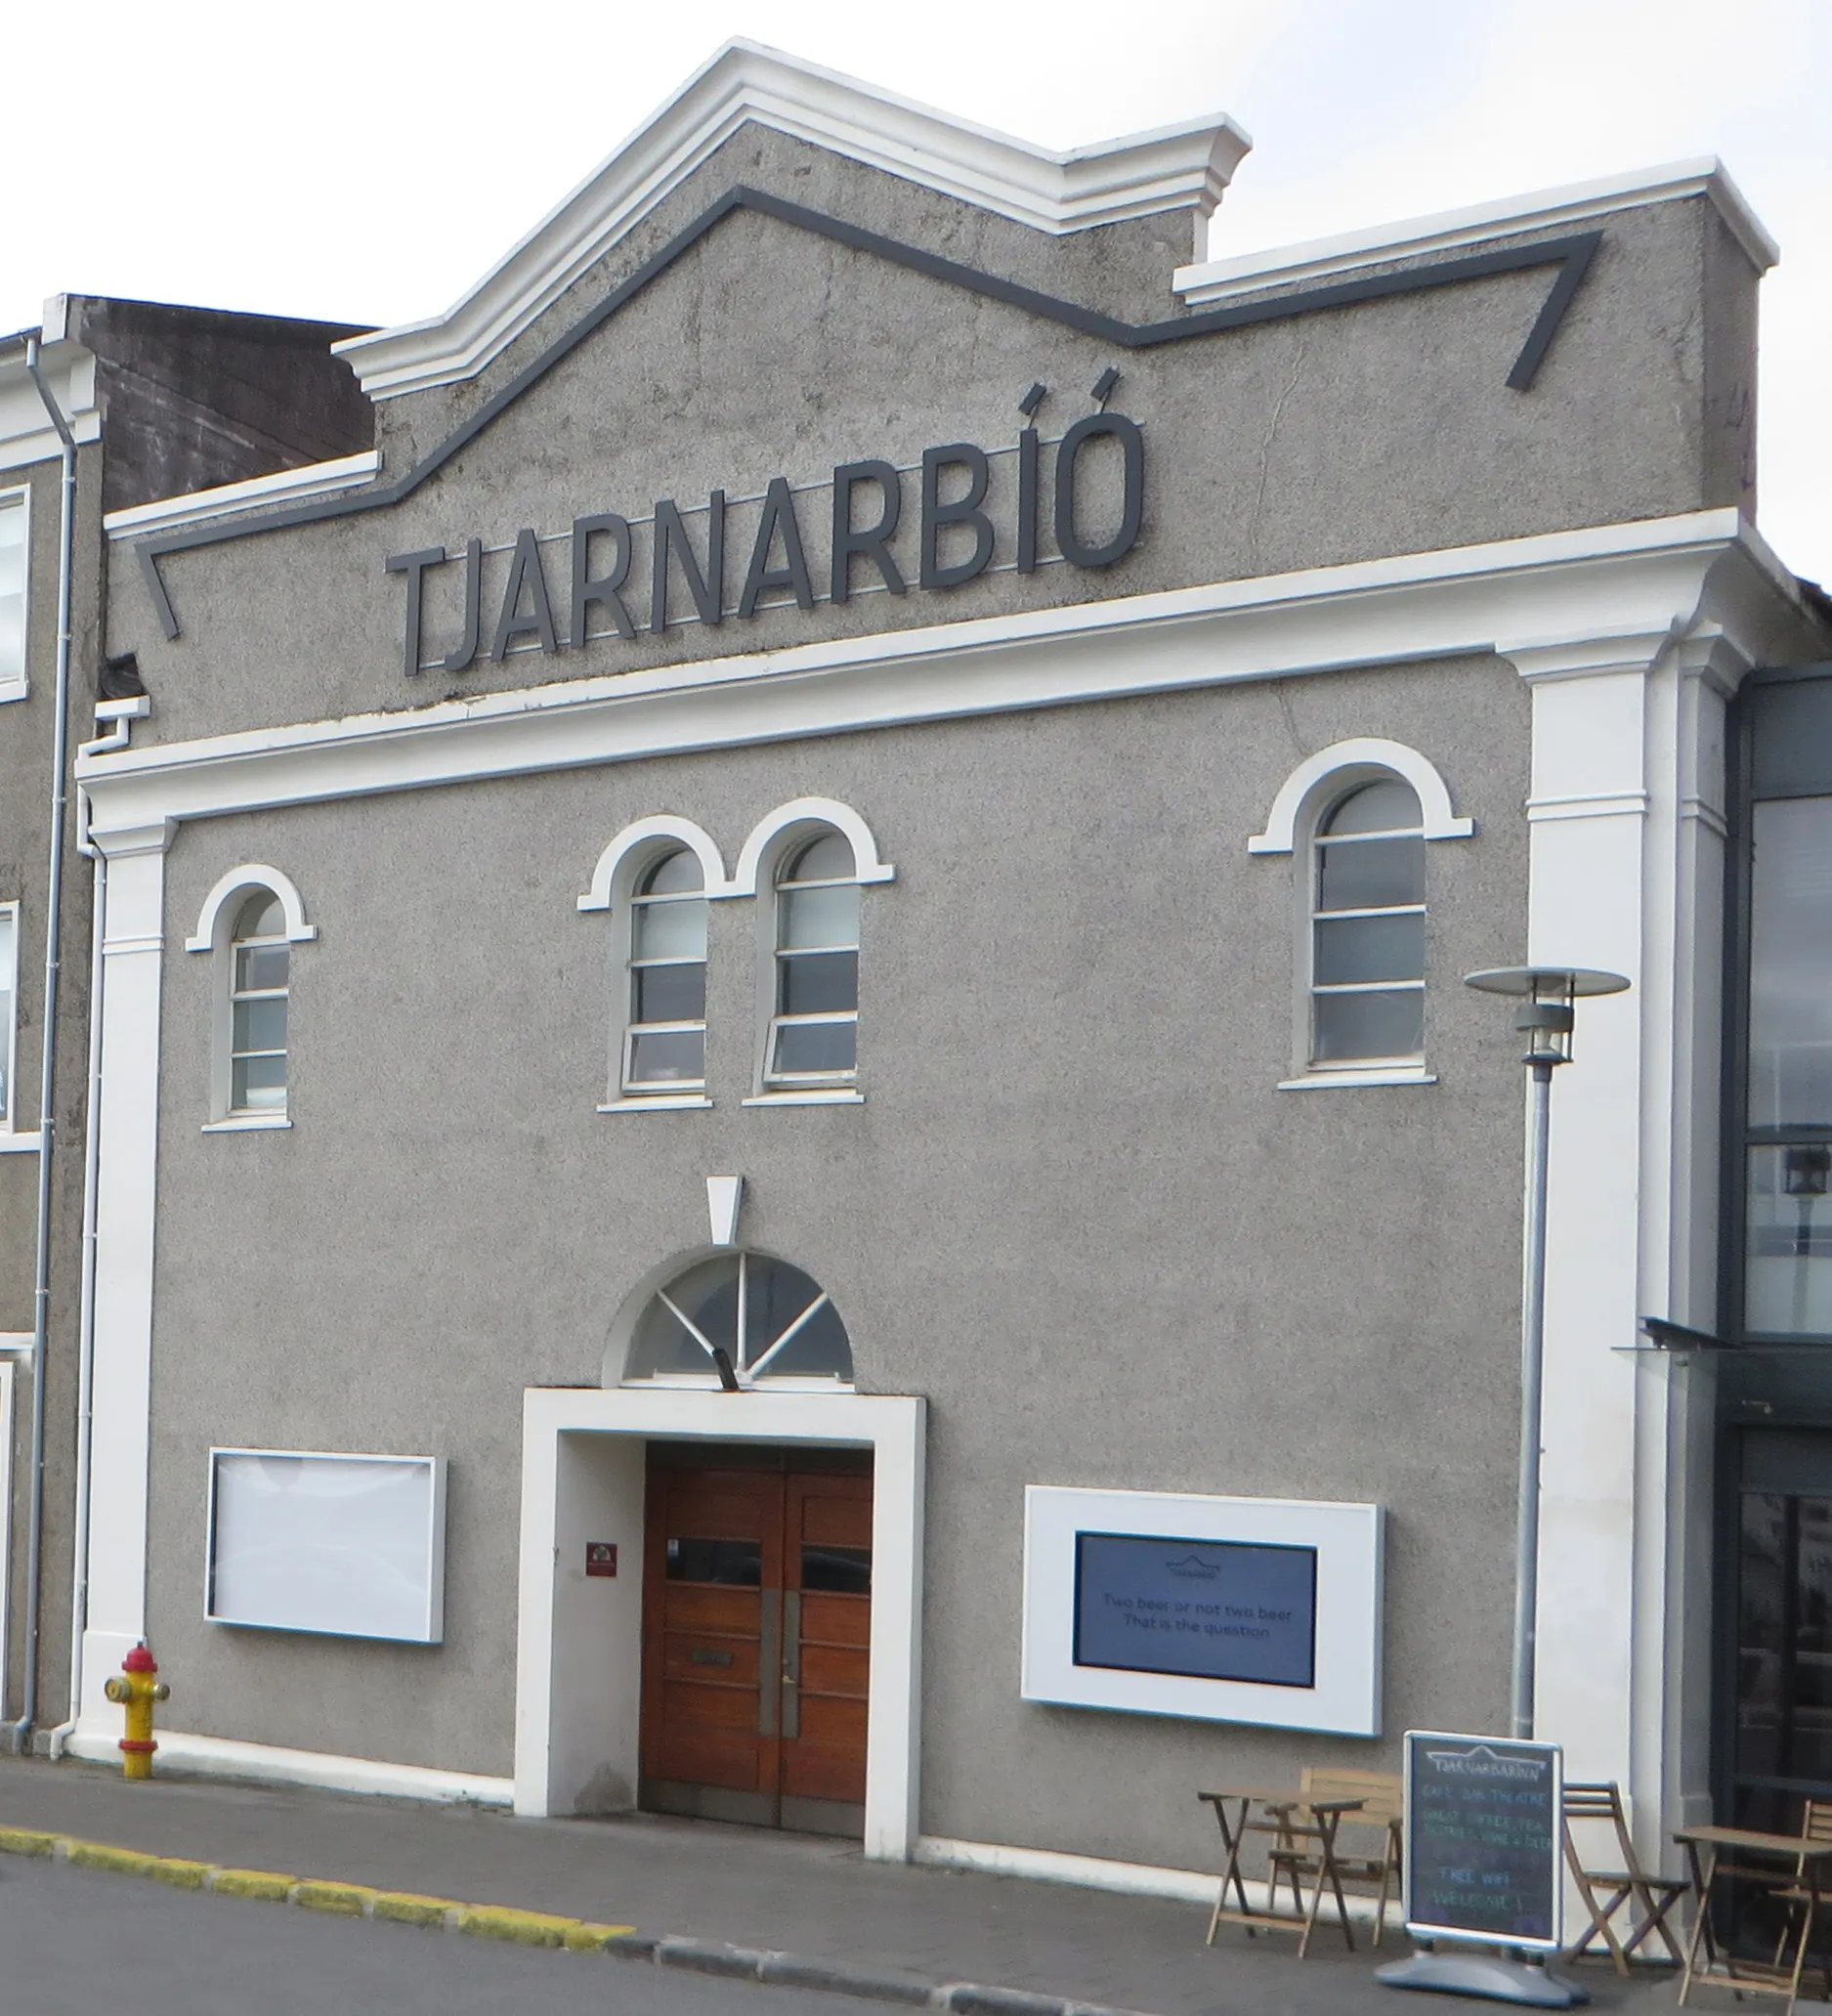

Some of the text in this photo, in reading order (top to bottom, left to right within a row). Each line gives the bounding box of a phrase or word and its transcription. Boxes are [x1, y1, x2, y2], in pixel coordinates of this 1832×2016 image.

[385, 367, 1144, 676] TJARNARBÍÓ
[1103, 1593, 1293, 1622] Two beer or not two beer
[1125, 1613, 1270, 1638] That is the question
